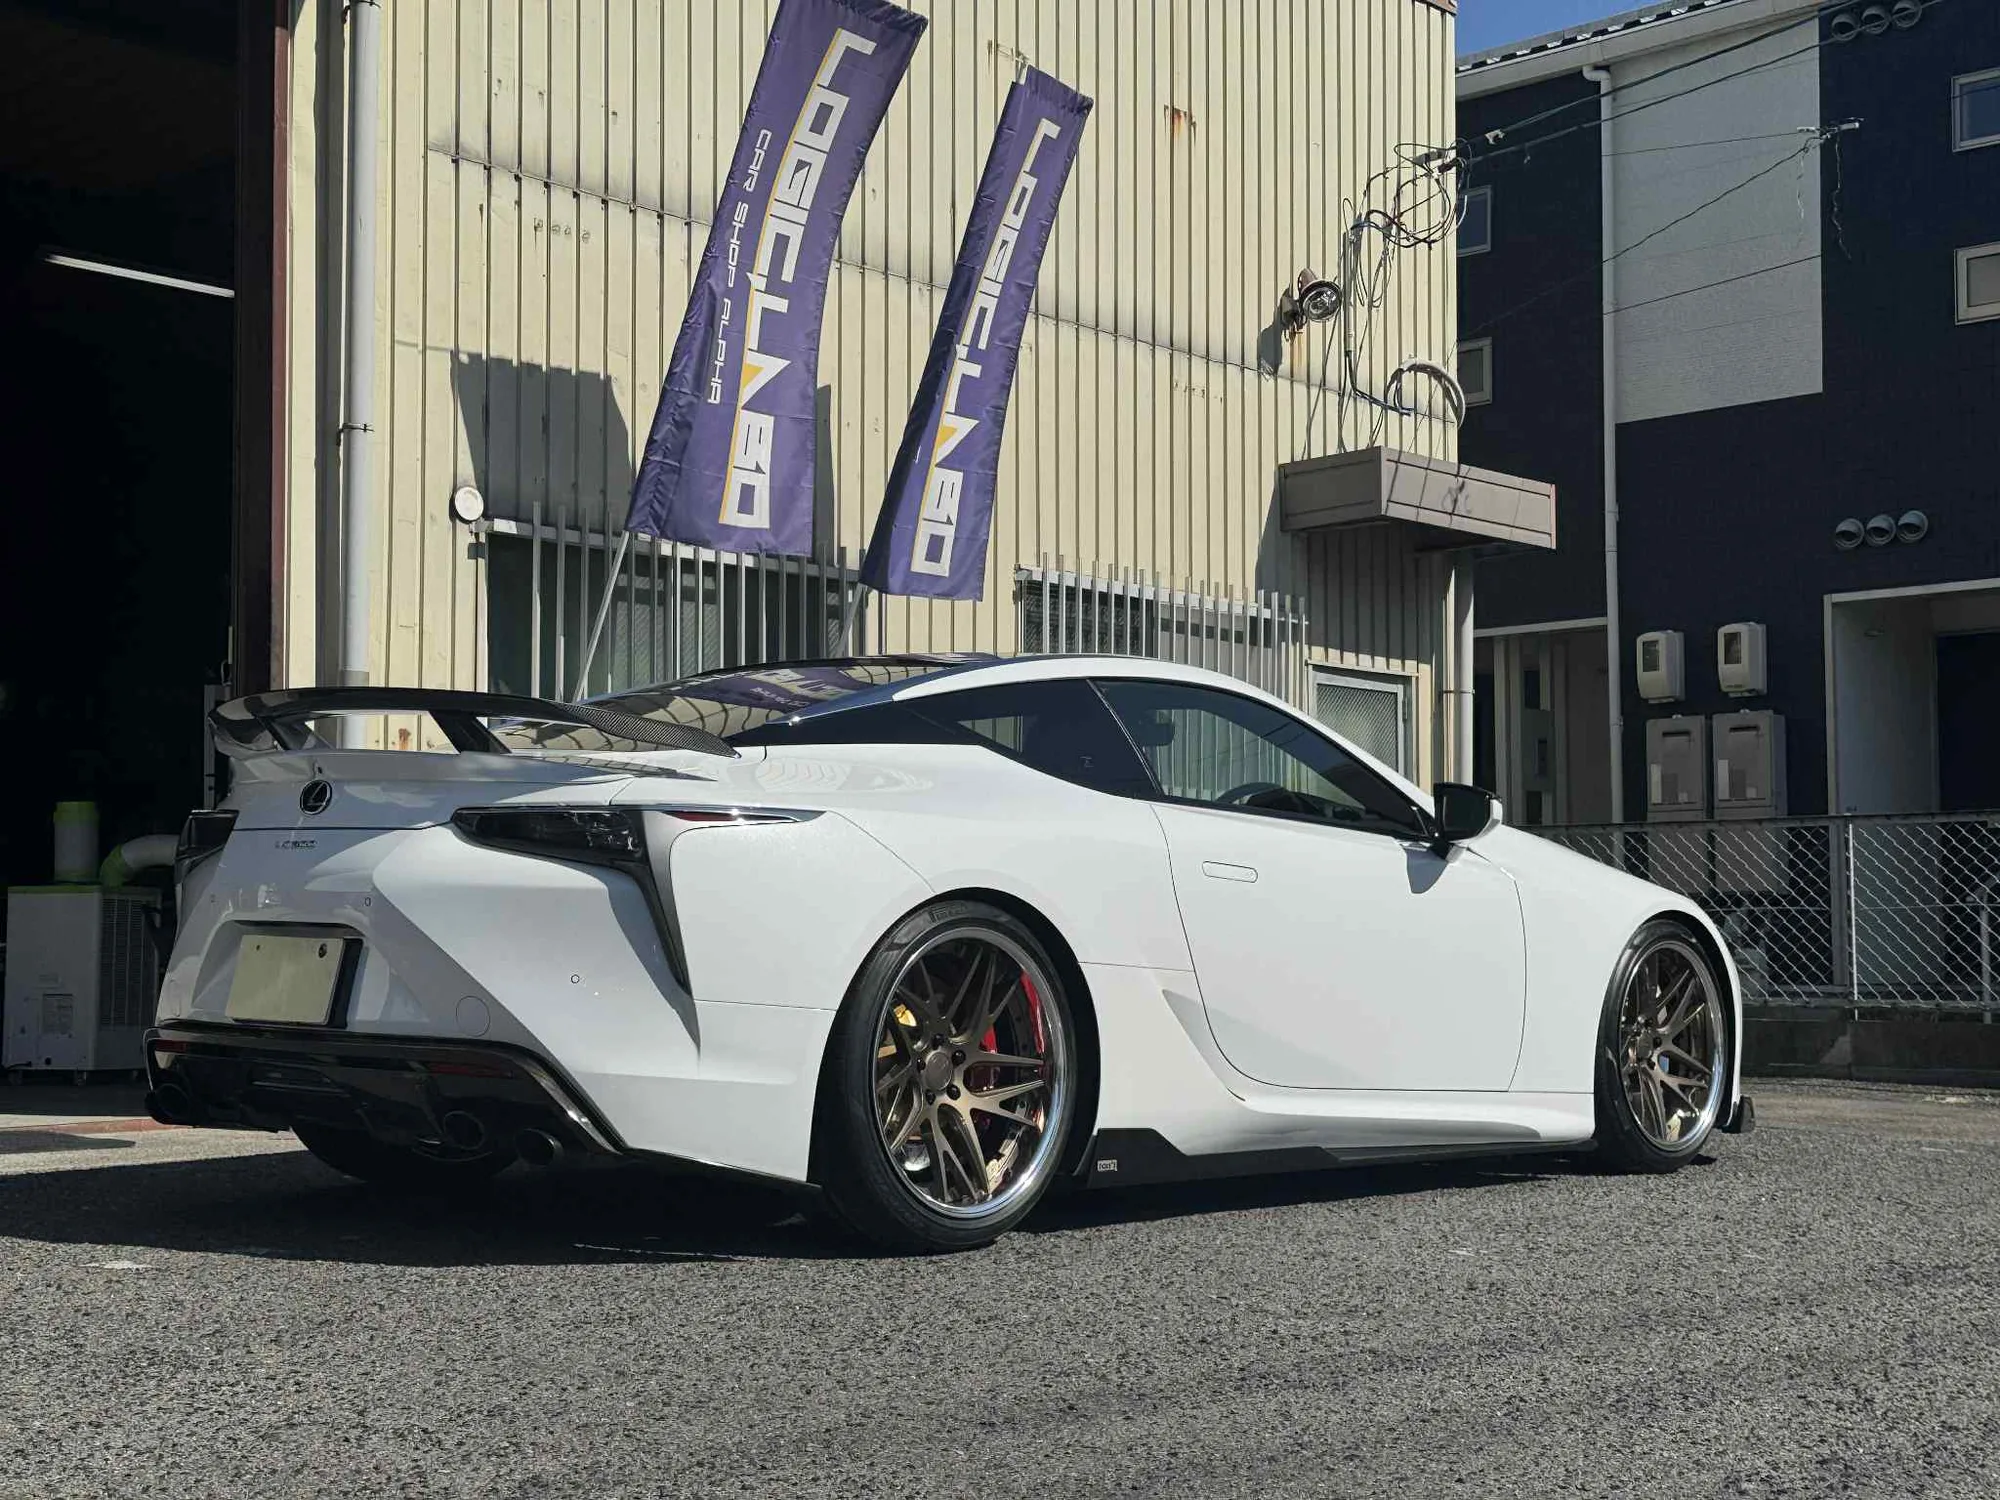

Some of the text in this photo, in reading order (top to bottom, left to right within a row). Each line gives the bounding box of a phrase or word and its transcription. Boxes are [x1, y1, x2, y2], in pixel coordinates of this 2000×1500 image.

[707, 128, 772, 404] CAR SHOP ALPHA
